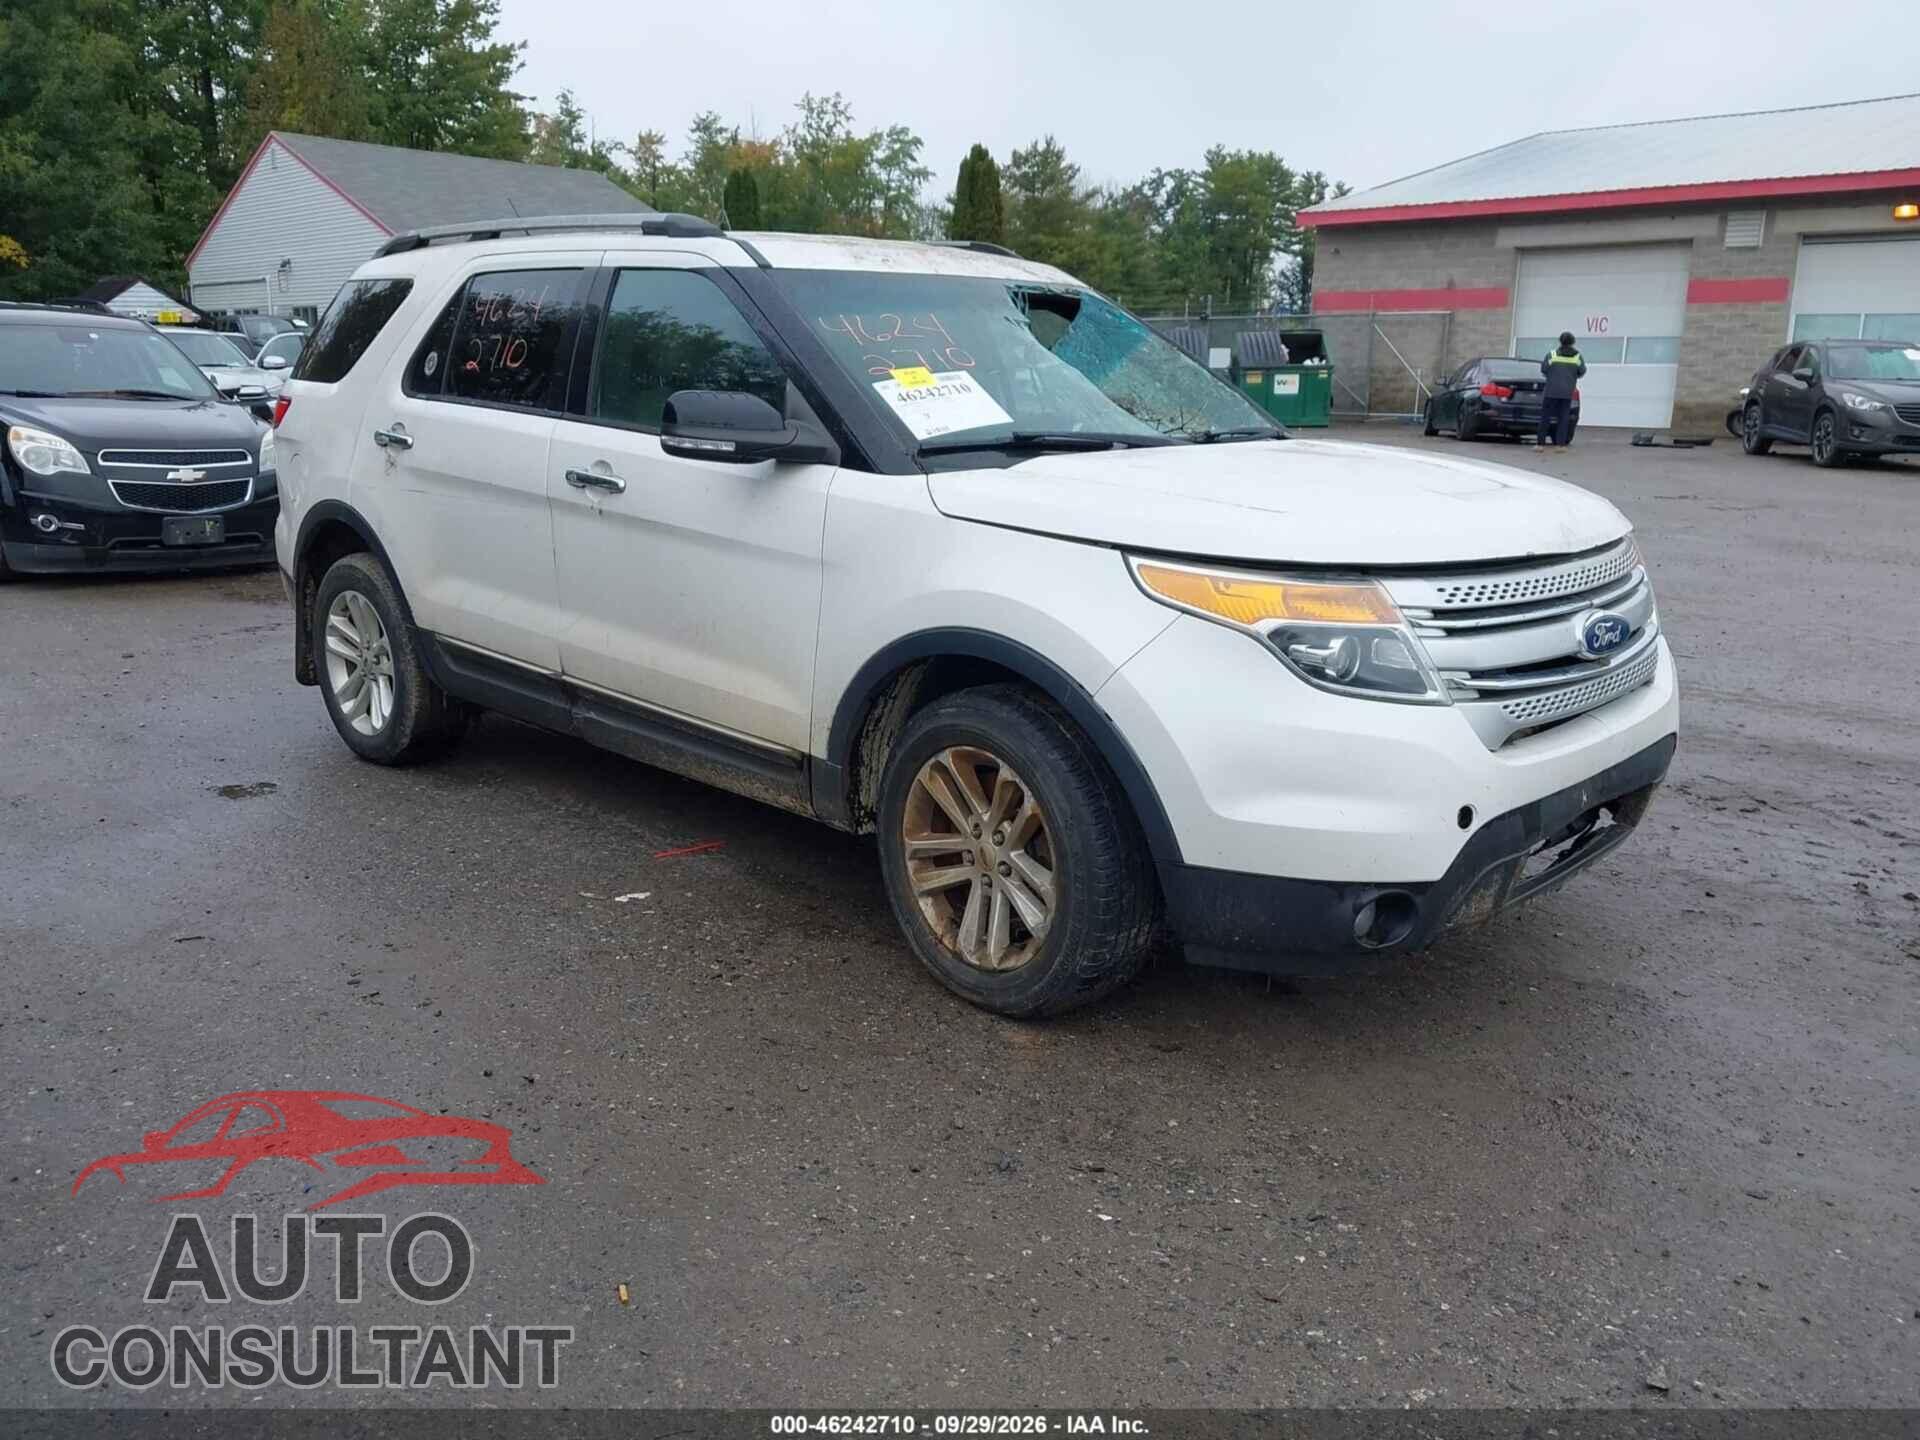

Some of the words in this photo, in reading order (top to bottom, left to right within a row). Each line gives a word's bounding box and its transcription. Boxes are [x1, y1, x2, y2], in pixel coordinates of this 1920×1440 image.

[475, 286, 549, 326] 4624
[818, 312, 955, 345] 4624
[1586, 316, 1609, 333] VIC
[466, 335, 527, 372] 2710
[863, 347, 975, 375] 2710
[897, 383, 972, 402] 46242710
[1593, 621, 1621, 648] Ford
